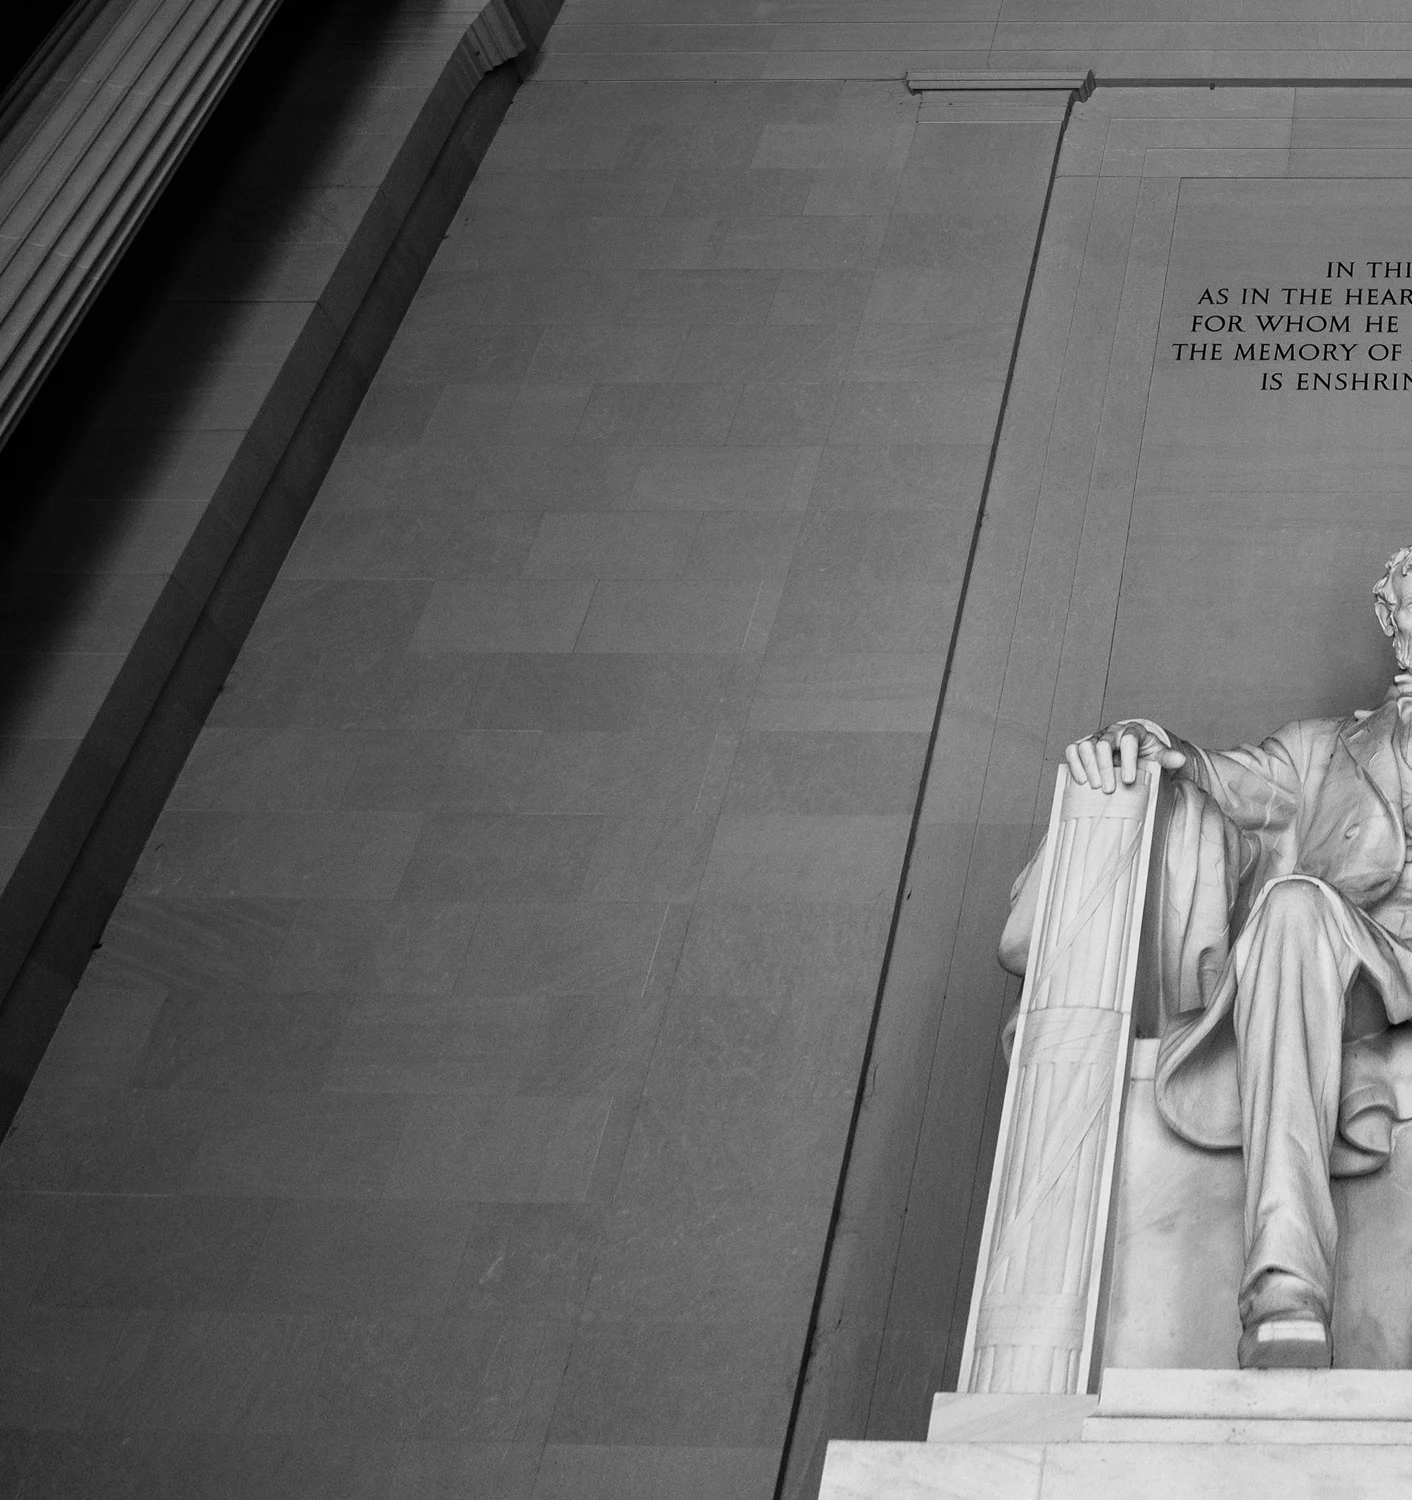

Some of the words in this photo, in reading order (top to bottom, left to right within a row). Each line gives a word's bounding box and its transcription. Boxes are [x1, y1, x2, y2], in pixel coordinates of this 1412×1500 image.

[1326, 261, 1356, 279] IN
[1196, 287, 1230, 306] AS
[1240, 287, 1271, 306] IN
[1280, 287, 1333, 306] THE
[1189, 314, 1247, 333] FOR
[1254, 314, 1352, 333] WHOM
[1364, 315, 1399, 334] HE
[1171, 342, 1223, 361] THE
[1232, 342, 1360, 362] MEMORY
[1367, 343, 1402, 362] OF
[1259, 372, 1283, 391] IS
